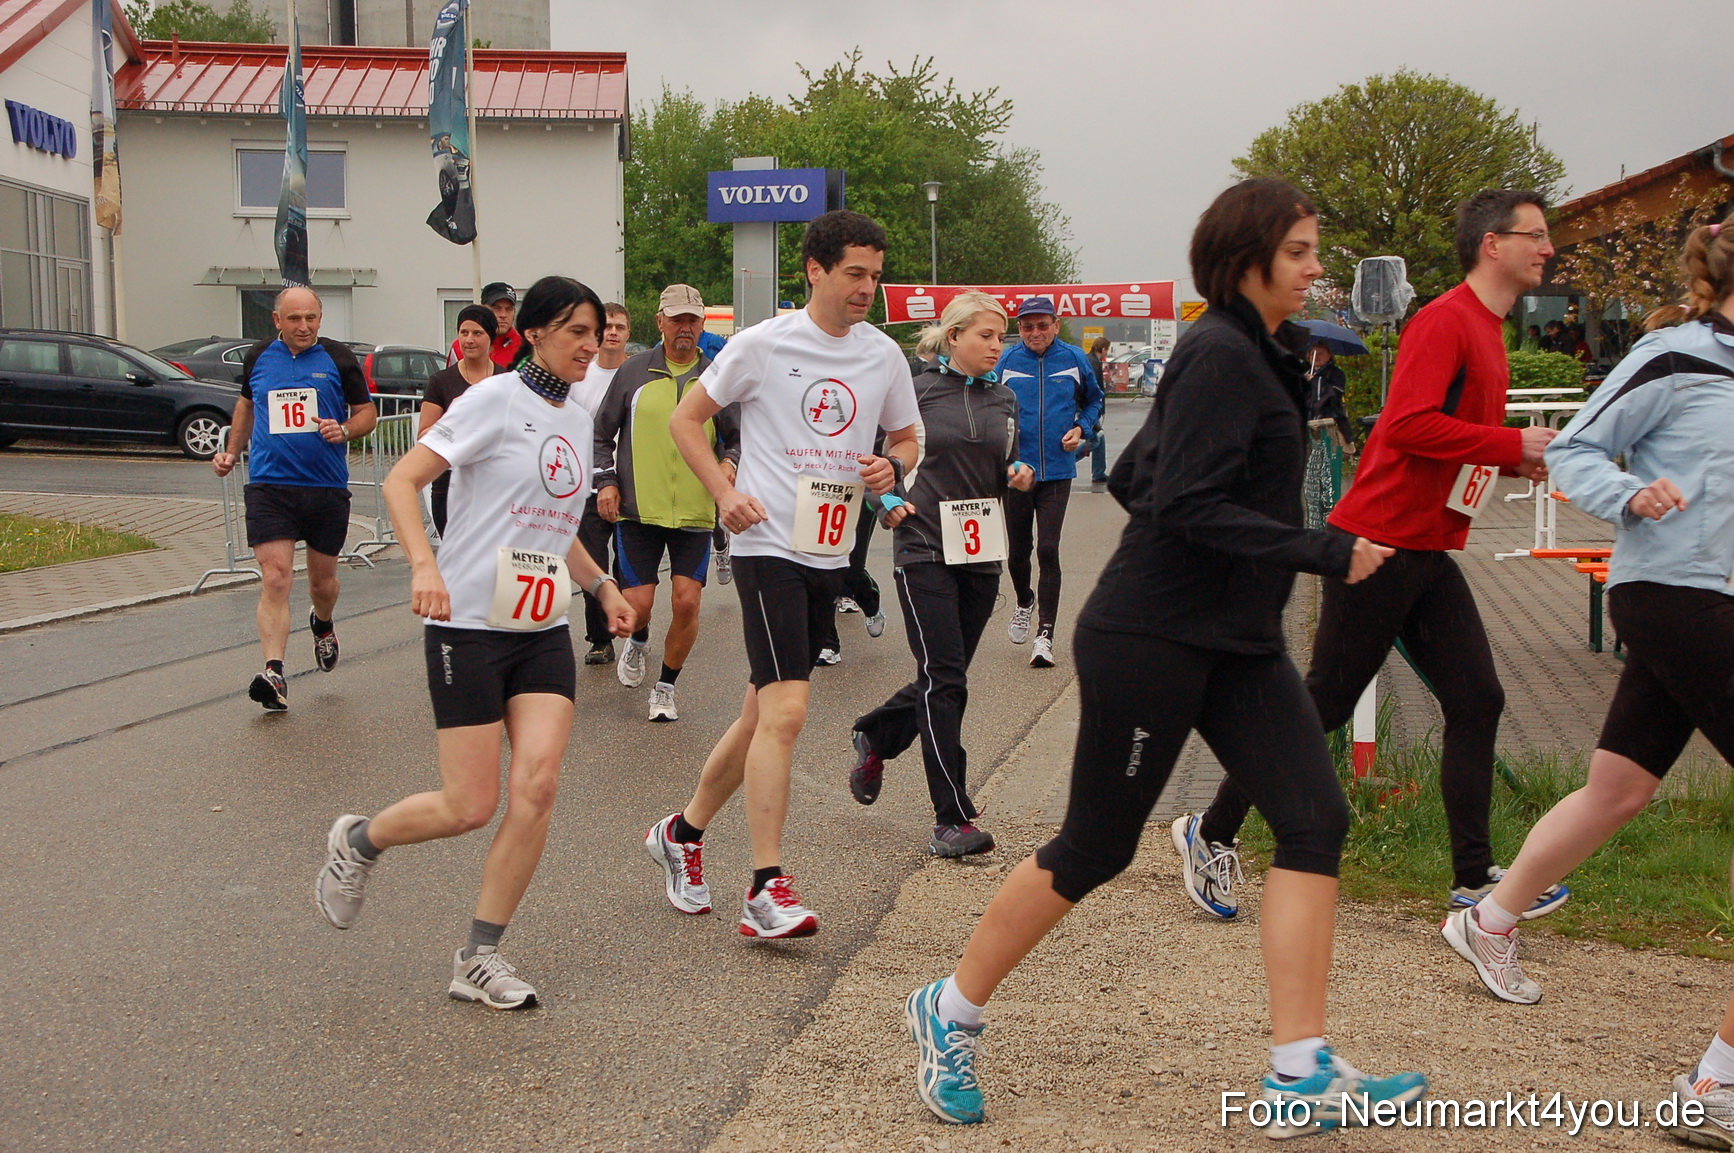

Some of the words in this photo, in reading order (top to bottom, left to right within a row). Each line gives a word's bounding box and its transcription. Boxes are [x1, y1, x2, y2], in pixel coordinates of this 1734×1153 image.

[4, 98, 77, 159] VOLVO
[718, 184, 809, 205] VOLVO
[281, 402, 306, 428] 16
[785, 447, 822, 457] LAUFEN
[826, 449, 842, 459] MIT
[845, 449, 866, 461] HER
[810, 491, 843, 500] WERBUNG
[811, 481, 844, 493] MEYER
[1462, 465, 1492, 509] 67
[951, 502, 980, 511] MEYER
[817, 502, 847, 547] 19
[964, 518, 981, 556] 3
[512, 551, 545, 564] MEYER
[512, 574, 555, 622] 70
